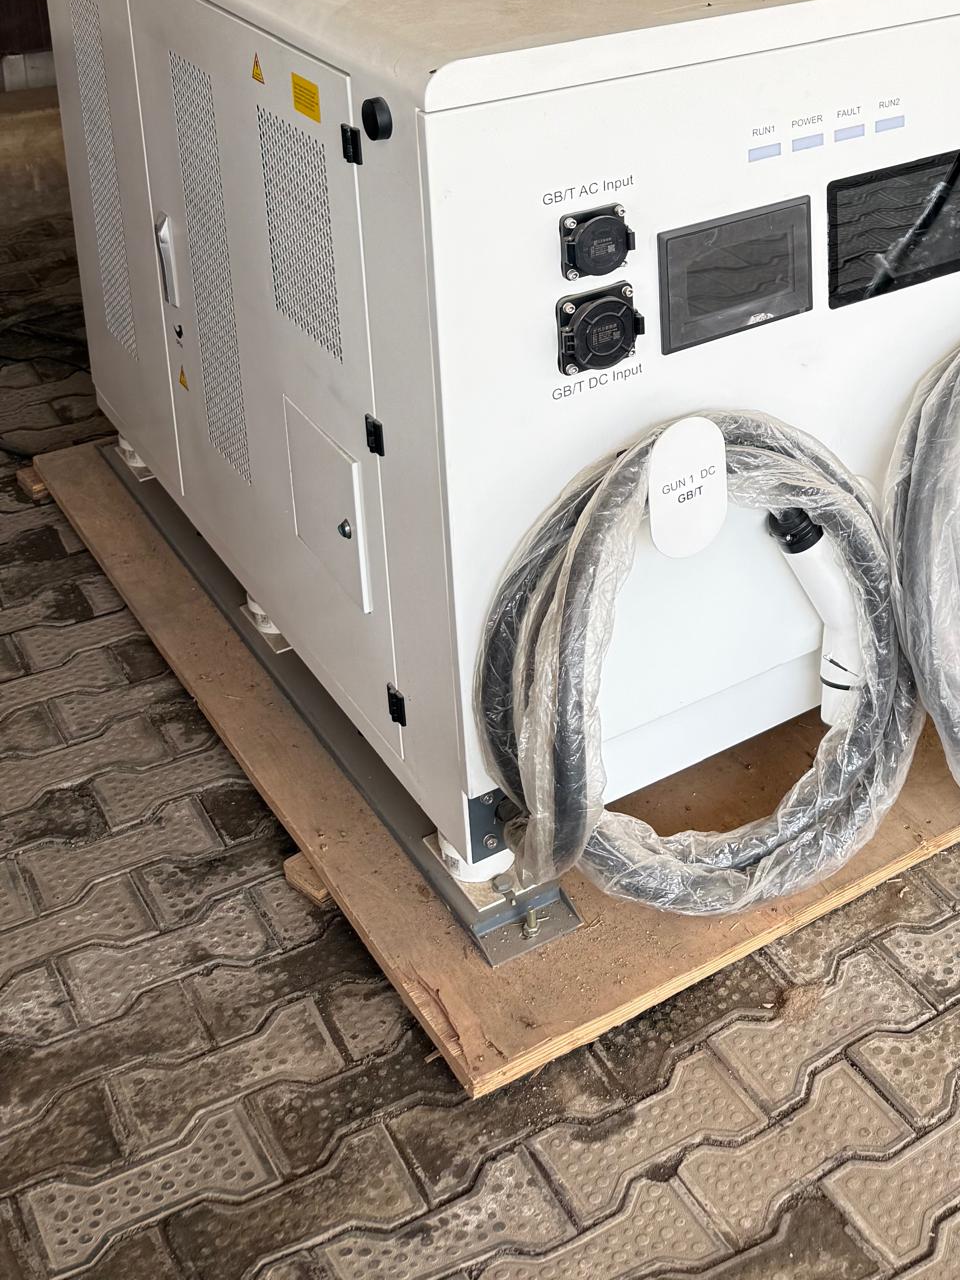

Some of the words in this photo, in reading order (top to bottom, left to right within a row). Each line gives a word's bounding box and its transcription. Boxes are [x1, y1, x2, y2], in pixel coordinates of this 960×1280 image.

[752, 125, 776, 137] RUN1
[791, 115, 823, 129] POWER
[836, 106, 862, 119] FAULT
[878, 98, 901, 109] RUN2
[542, 187, 576, 205] GB/T
[579, 182, 599, 197] AC
[603, 174, 634, 191] Input
[552, 381, 585, 401] GB/T
[588, 373, 609, 390] DC
[612, 363, 643, 382] Input
[662, 477, 686, 495] GUN
[700, 465, 716, 479] DC
[677, 485, 703, 504] GB/T
